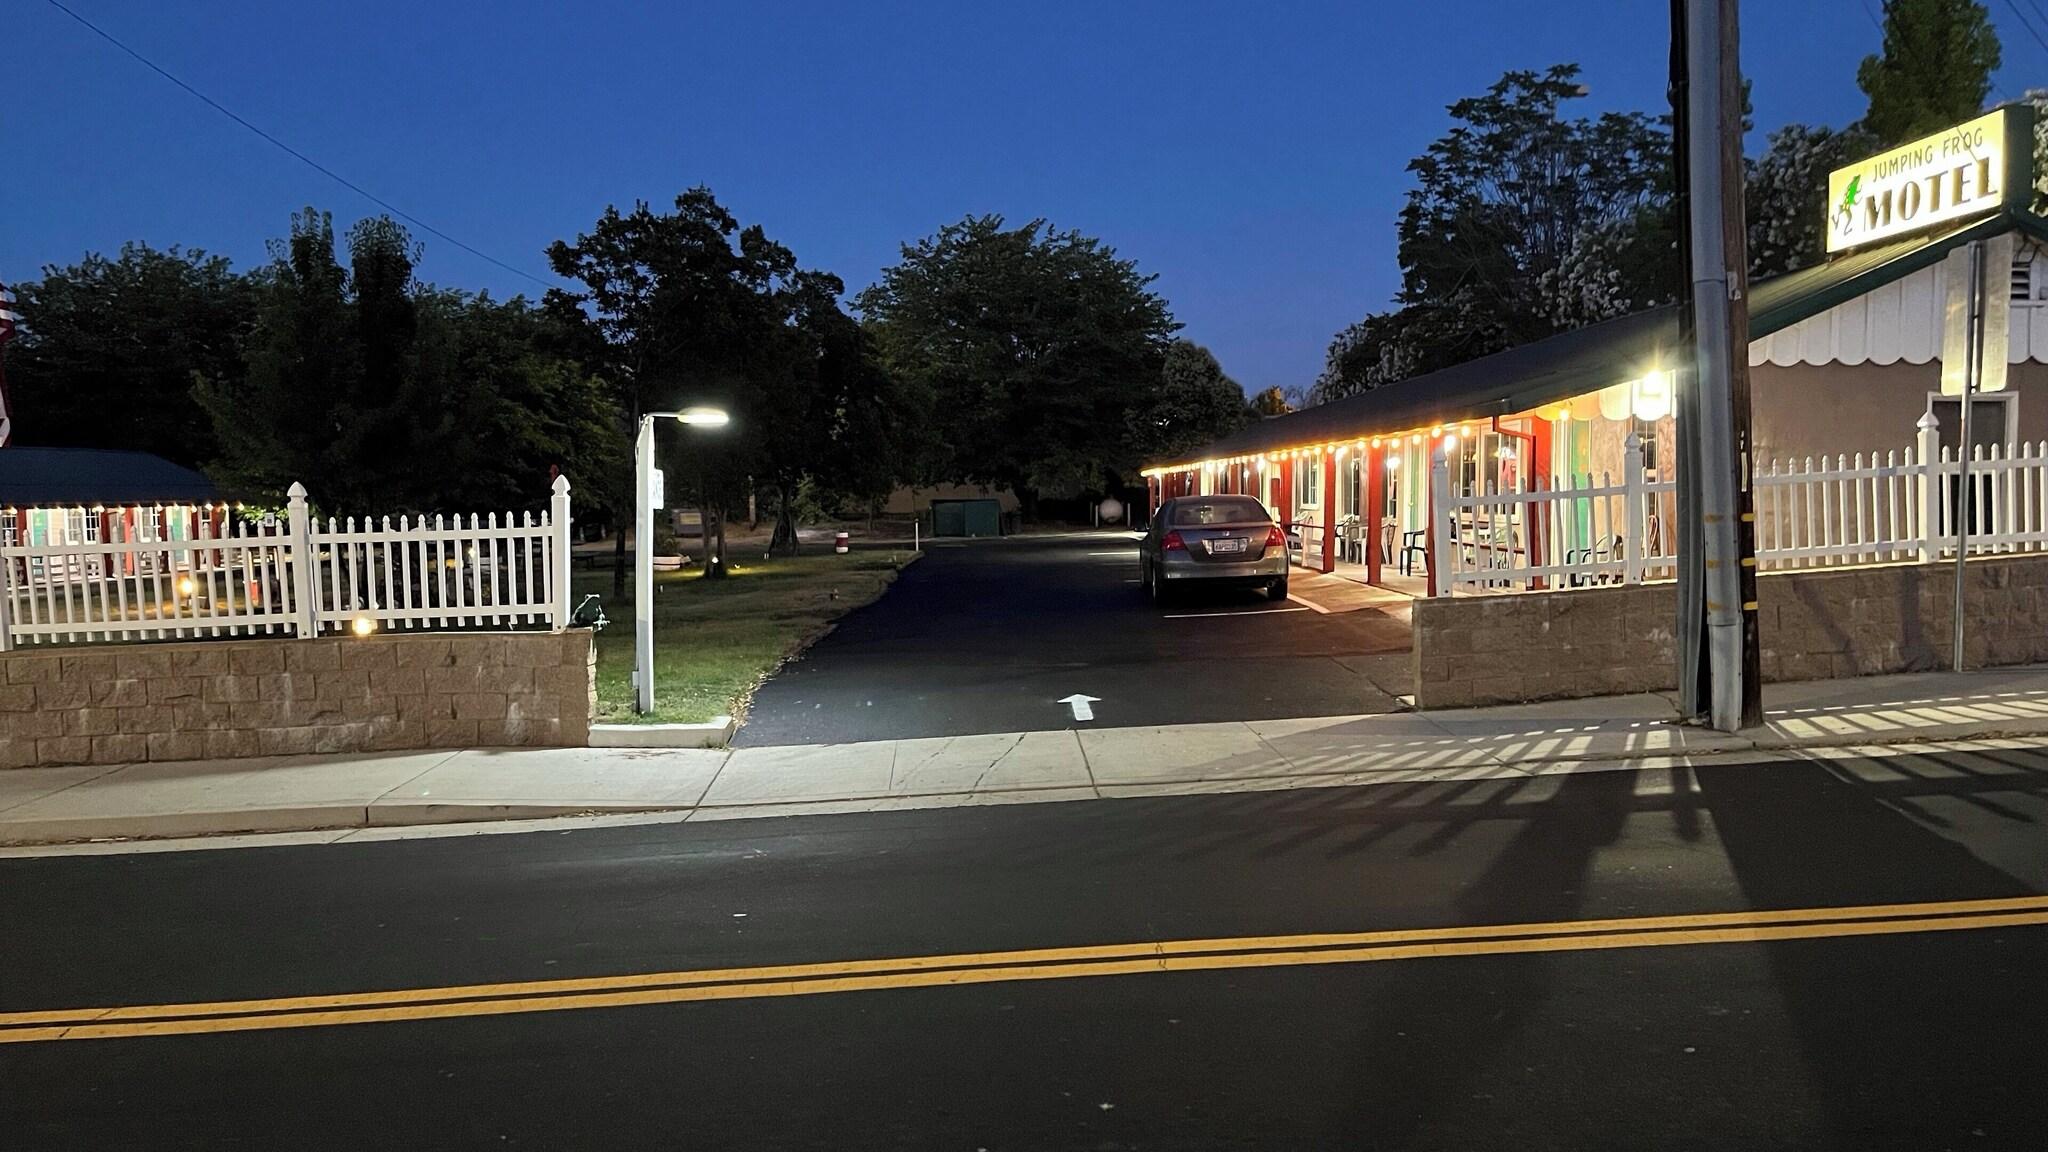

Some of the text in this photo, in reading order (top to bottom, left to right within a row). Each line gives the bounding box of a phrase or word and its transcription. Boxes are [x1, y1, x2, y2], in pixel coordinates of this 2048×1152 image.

[1872, 127, 1983, 183] JUMPING FROG
[1863, 156, 1998, 233] MOTEL
